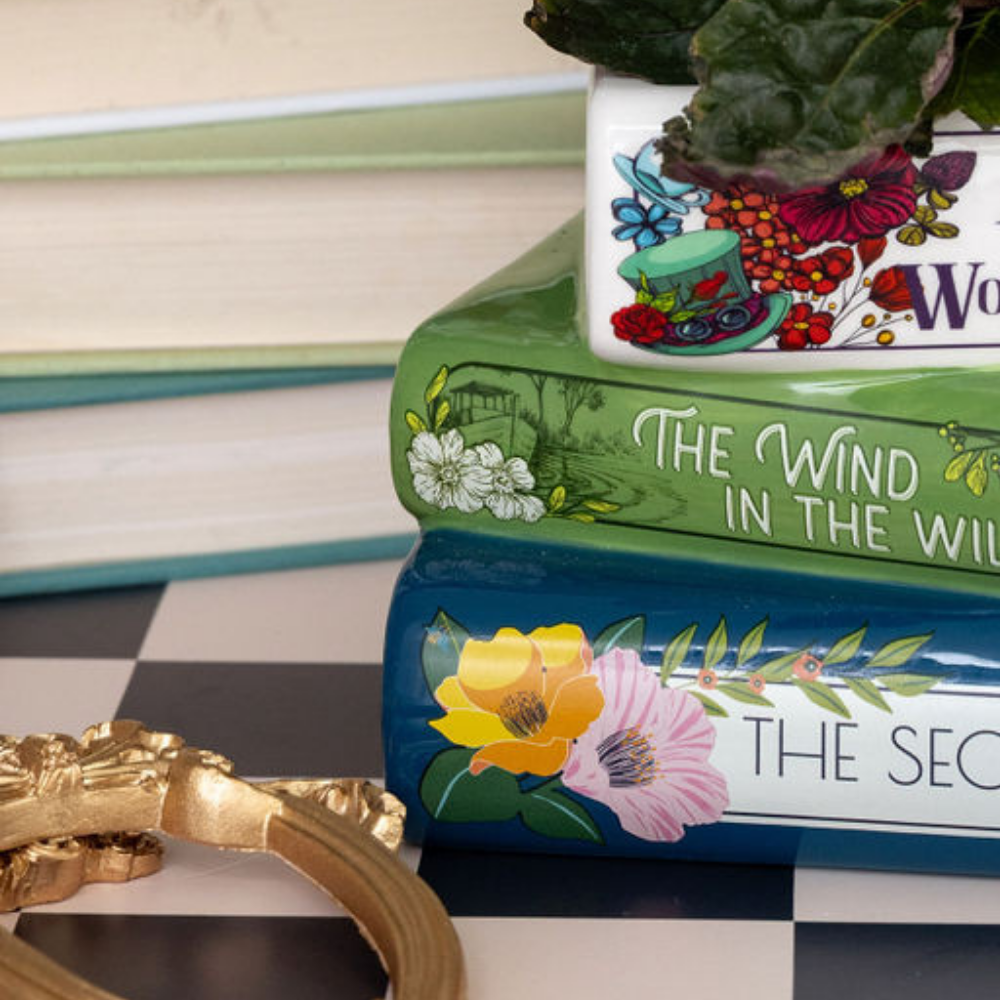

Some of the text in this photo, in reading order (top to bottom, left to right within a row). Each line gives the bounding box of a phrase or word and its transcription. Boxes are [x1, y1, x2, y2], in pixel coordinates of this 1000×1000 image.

[633, 406, 919, 501] THE WIND
[725, 485, 772, 536] IN
[793, 498, 891, 552] THE
[743, 716, 860, 782] THE
